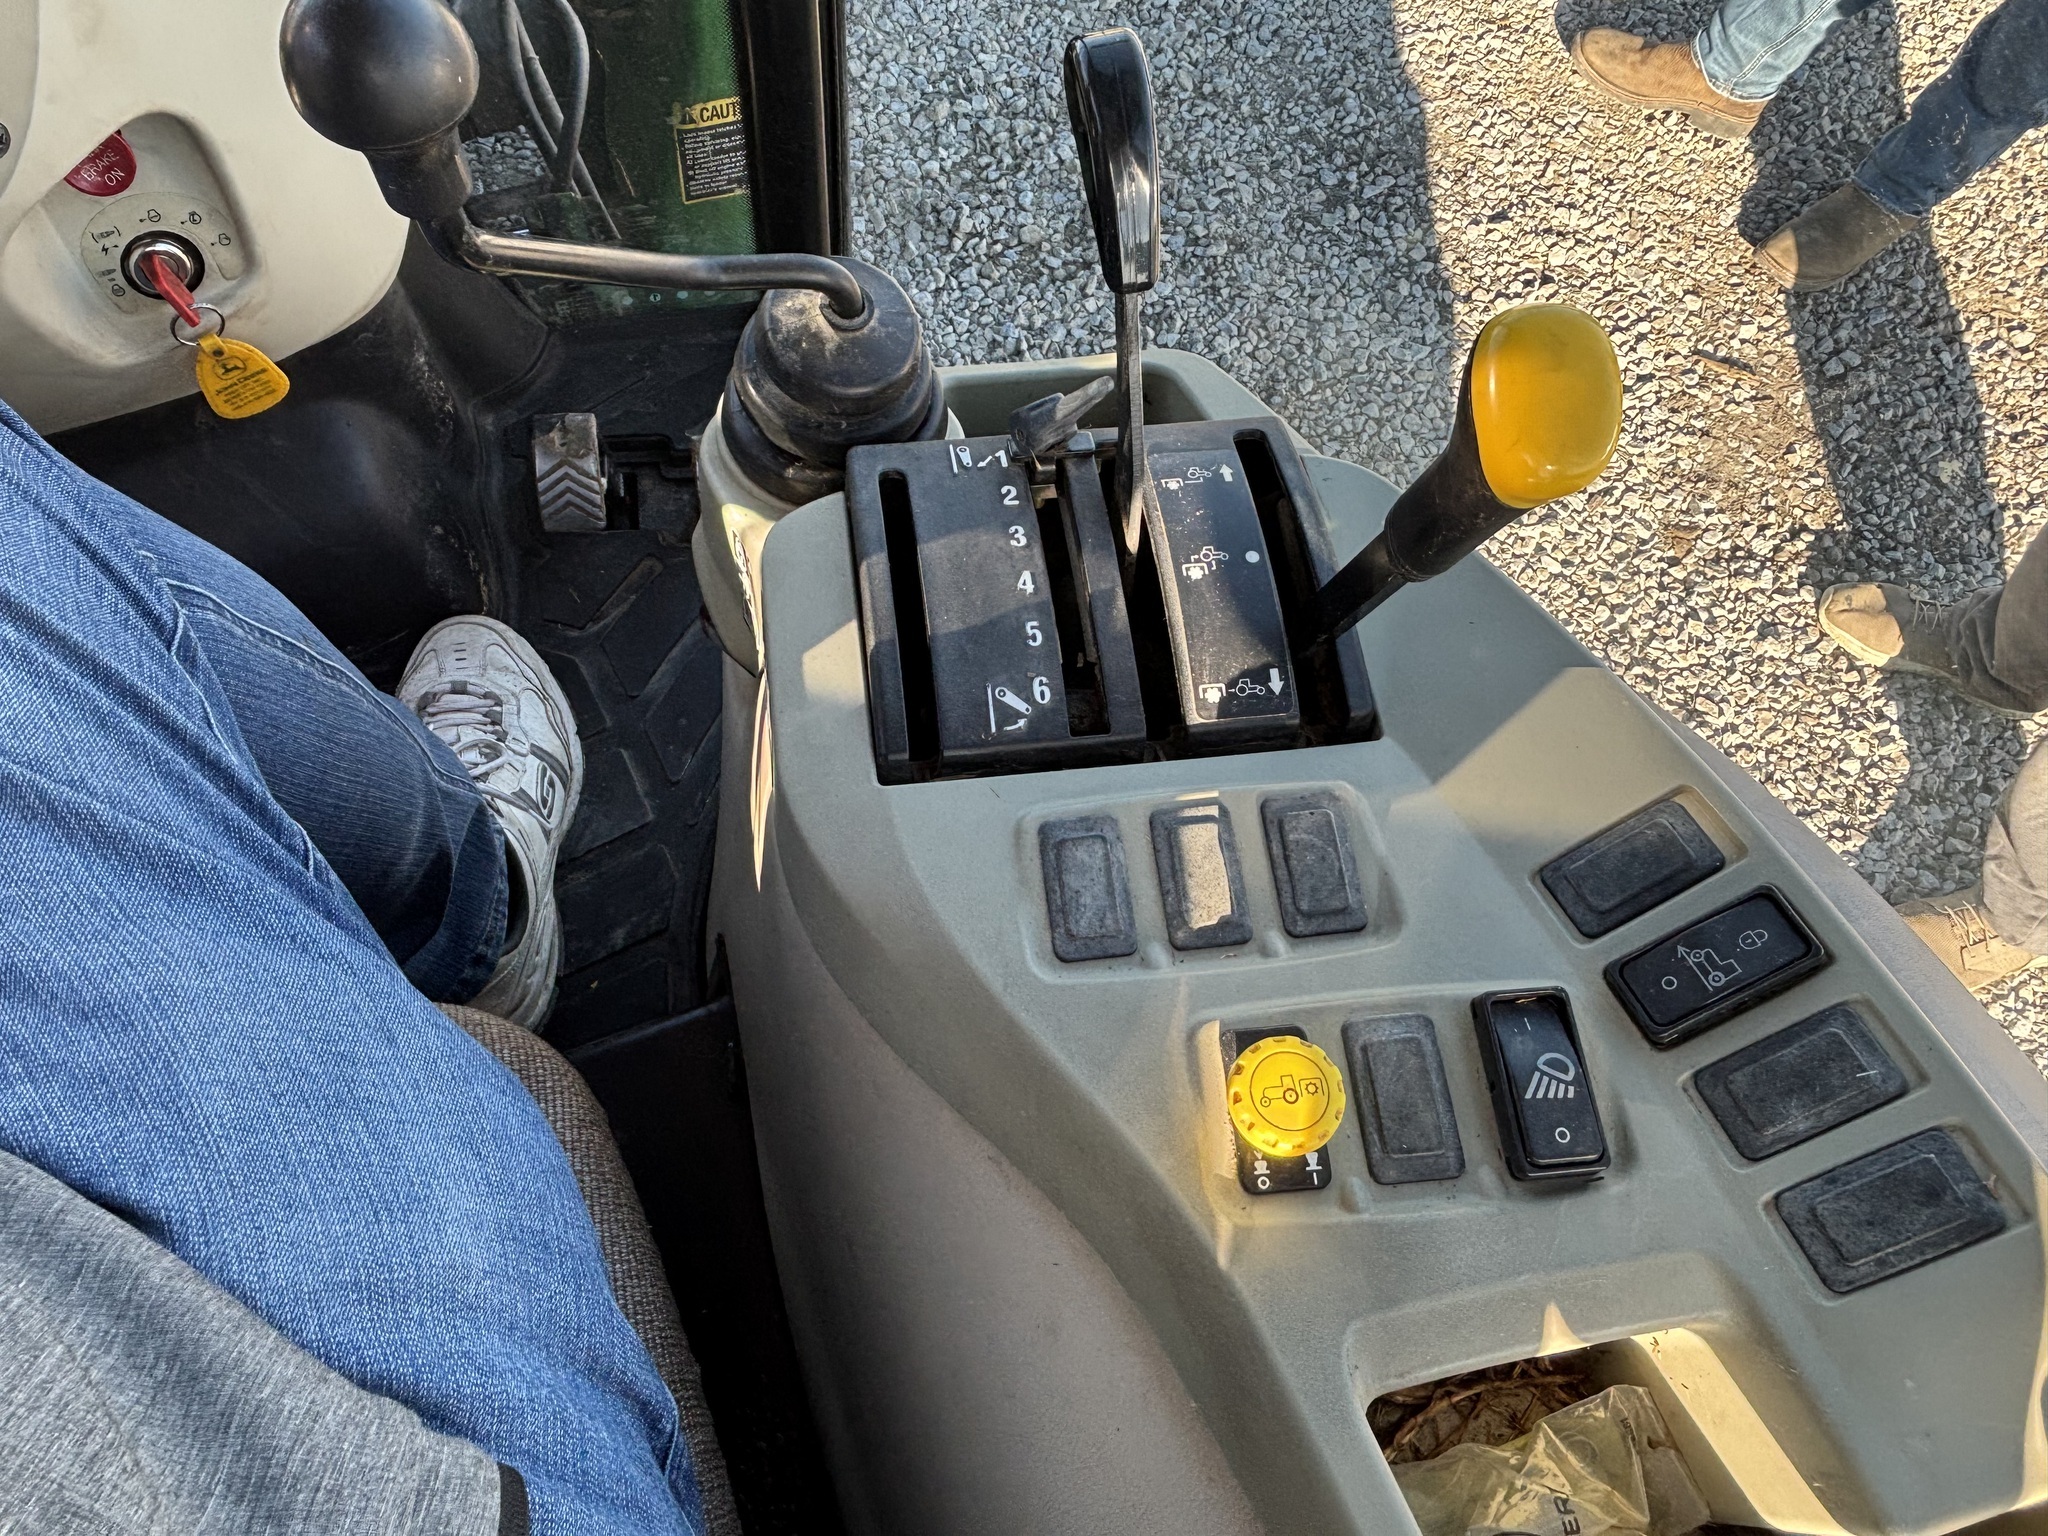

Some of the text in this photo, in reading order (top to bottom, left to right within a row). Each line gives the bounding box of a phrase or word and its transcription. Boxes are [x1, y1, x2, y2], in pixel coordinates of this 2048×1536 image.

[81, 150, 119, 180] BRAKE
[104, 167, 126, 187] ON
[1001, 485, 1020, 506] 2
[1009, 525, 1028, 547] 3
[1017, 570, 1035, 595] 4
[1025, 621, 1043, 647] 5
[1032, 676, 1052, 705] 6
